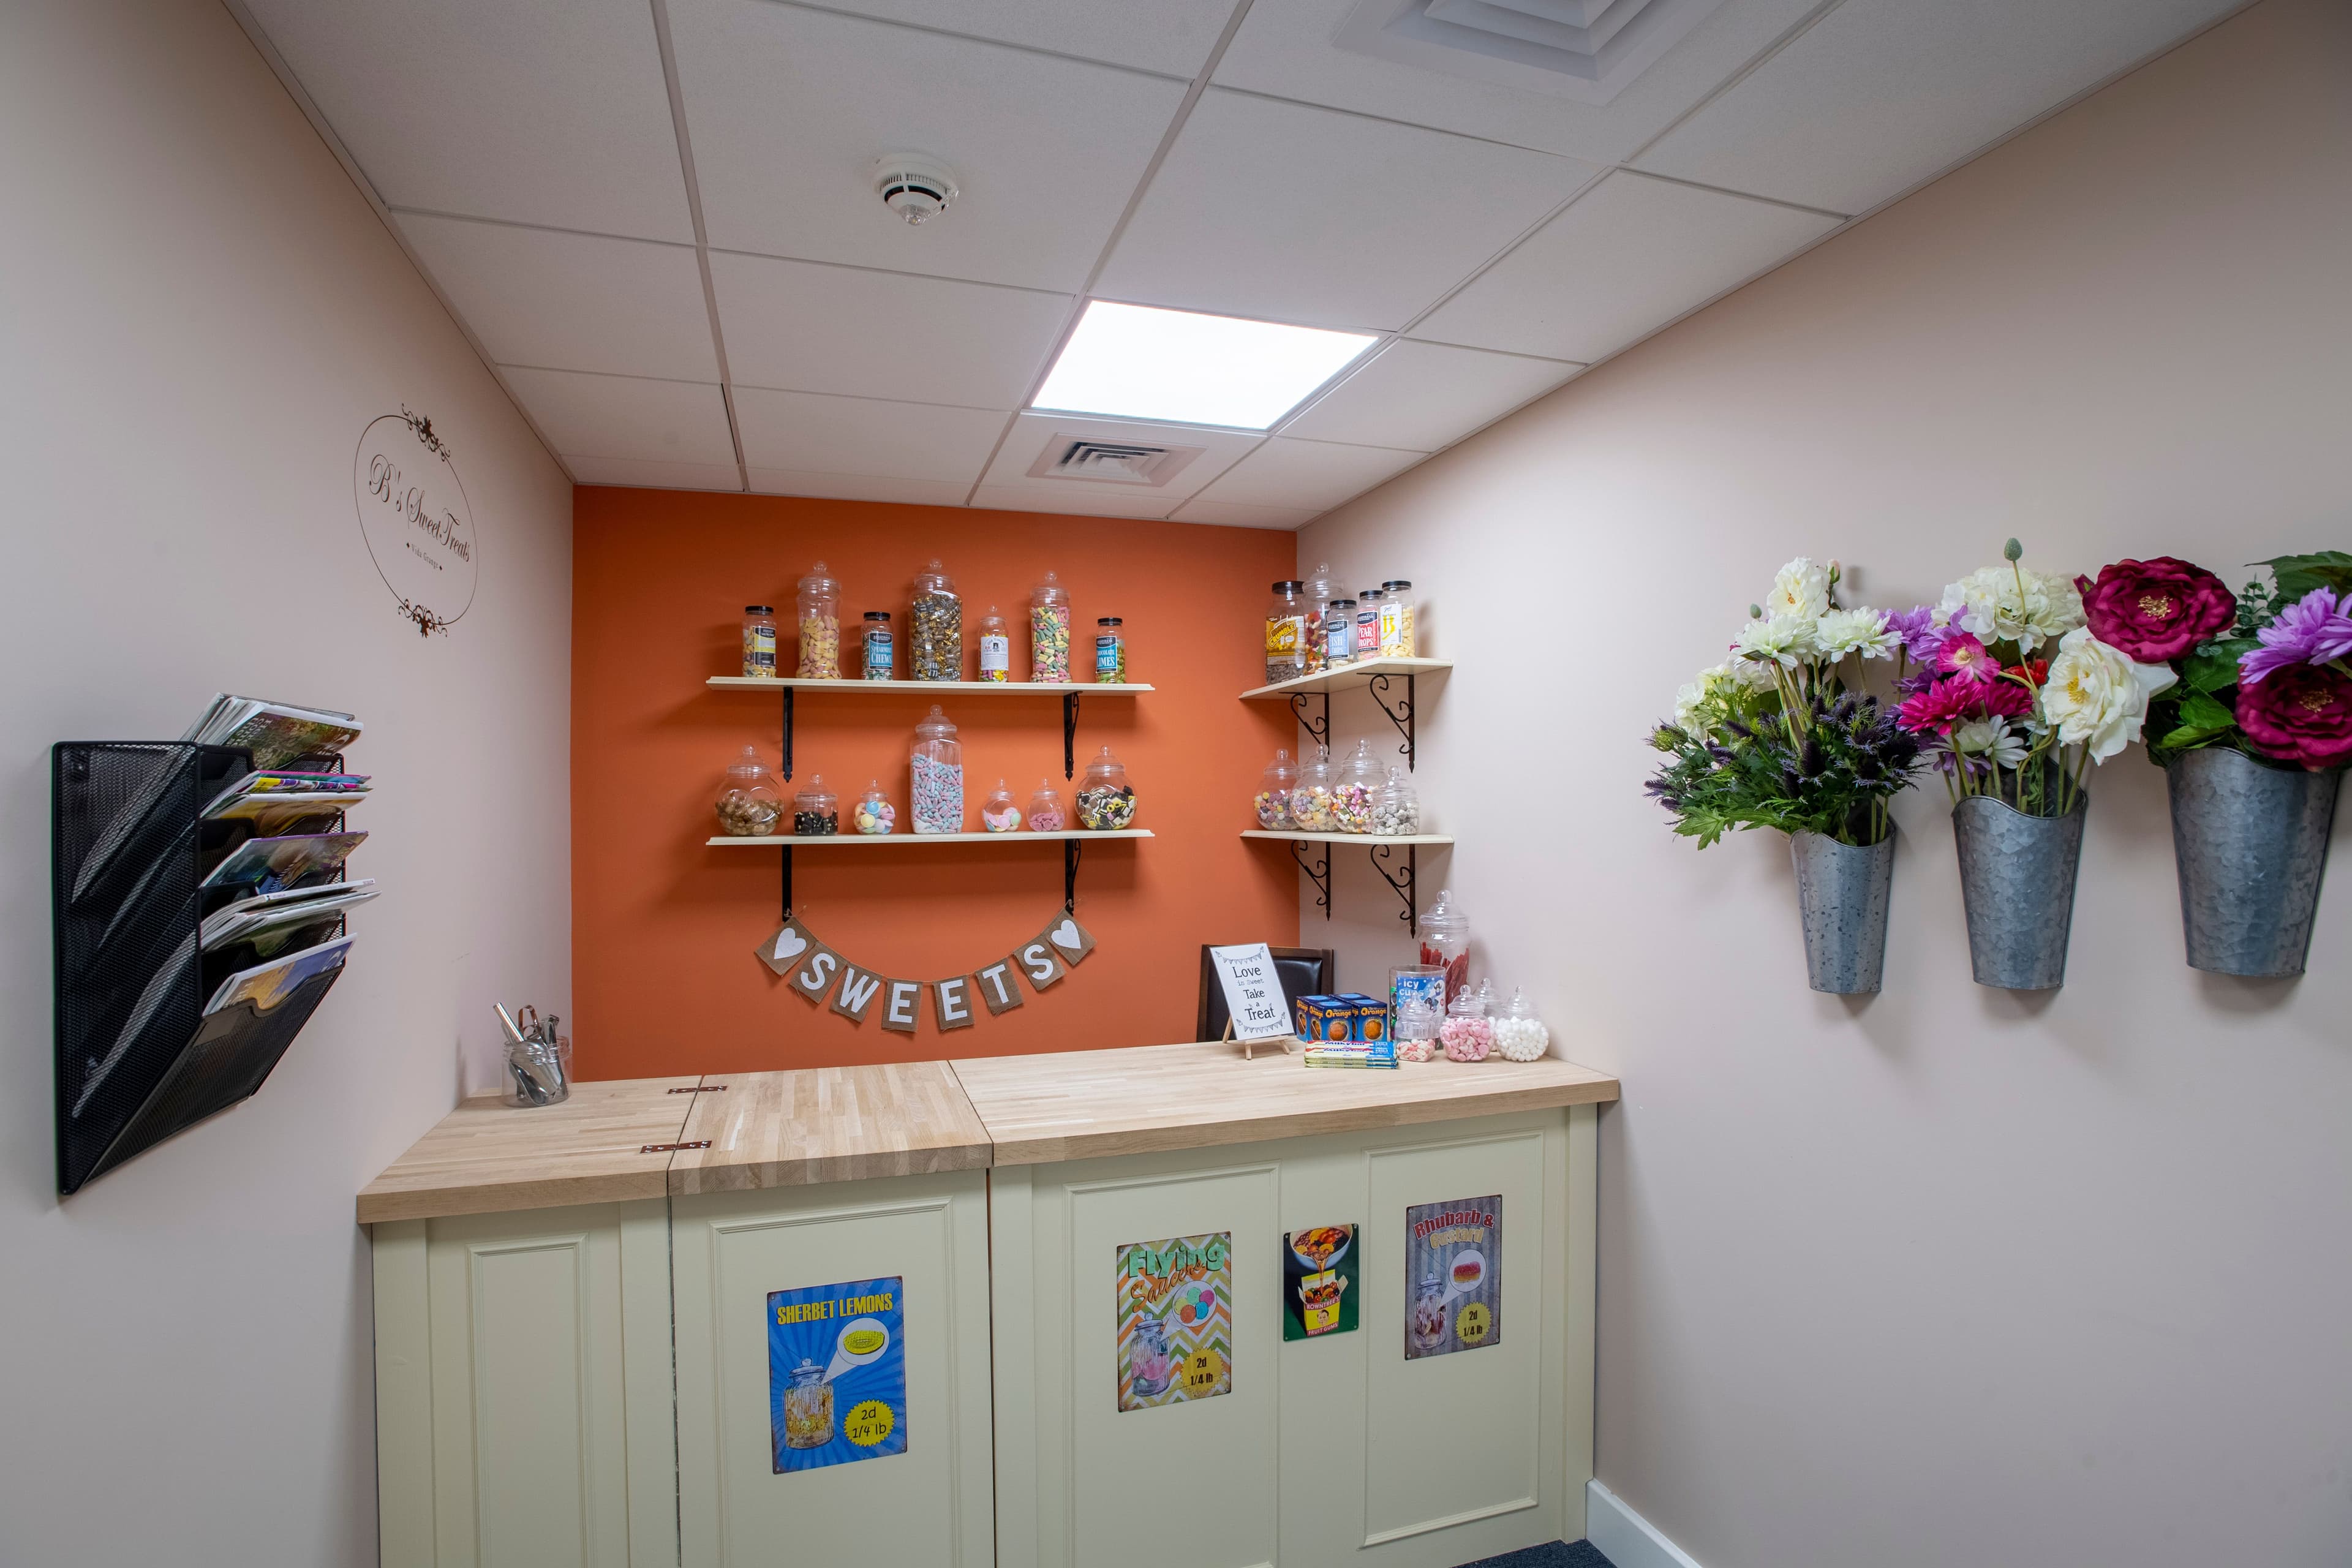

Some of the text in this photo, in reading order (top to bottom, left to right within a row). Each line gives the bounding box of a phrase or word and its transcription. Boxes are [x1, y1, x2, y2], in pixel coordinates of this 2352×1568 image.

[407, 487, 442, 540] Sweet
[440, 508, 470, 562] Treats
[1270, 624, 1295, 646] CRUMBLE
[871, 652, 892, 664] CHEWS
[1232, 966, 1262, 978] Love
[801, 944, 1054, 1023] SWEETS
[1403, 979, 1419, 989] icy
[1243, 988, 1265, 1000] Take
[1244, 1006, 1276, 1021] Treat
[1309, 1005, 1324, 1020] Orange
[1325, 1009, 1352, 1018] Orange
[1360, 1007, 1387, 1017] Orange
[1413, 1208, 1494, 1240] Rhubarb &
[1430, 1227, 1485, 1250] Custard
[1128, 1245, 1225, 1280] Flying
[1131, 1259, 1206, 1313] Saucers
[777, 1292, 894, 1325] SHERBET LEMONS
[1306, 1296, 1340, 1310] ROWNTREE'S
[1469, 1310, 1477, 1321] 2d
[1324, 1322, 1338, 1332] GUMS
[1464, 1325, 1483, 1337] 1/4 lb
[1196, 1357, 1207, 1369] 2d
[1190, 1371, 1213, 1385] 1/4 lb
[861, 1407, 876, 1420] 2d
[852, 1422, 887, 1439] 1/4 lb
